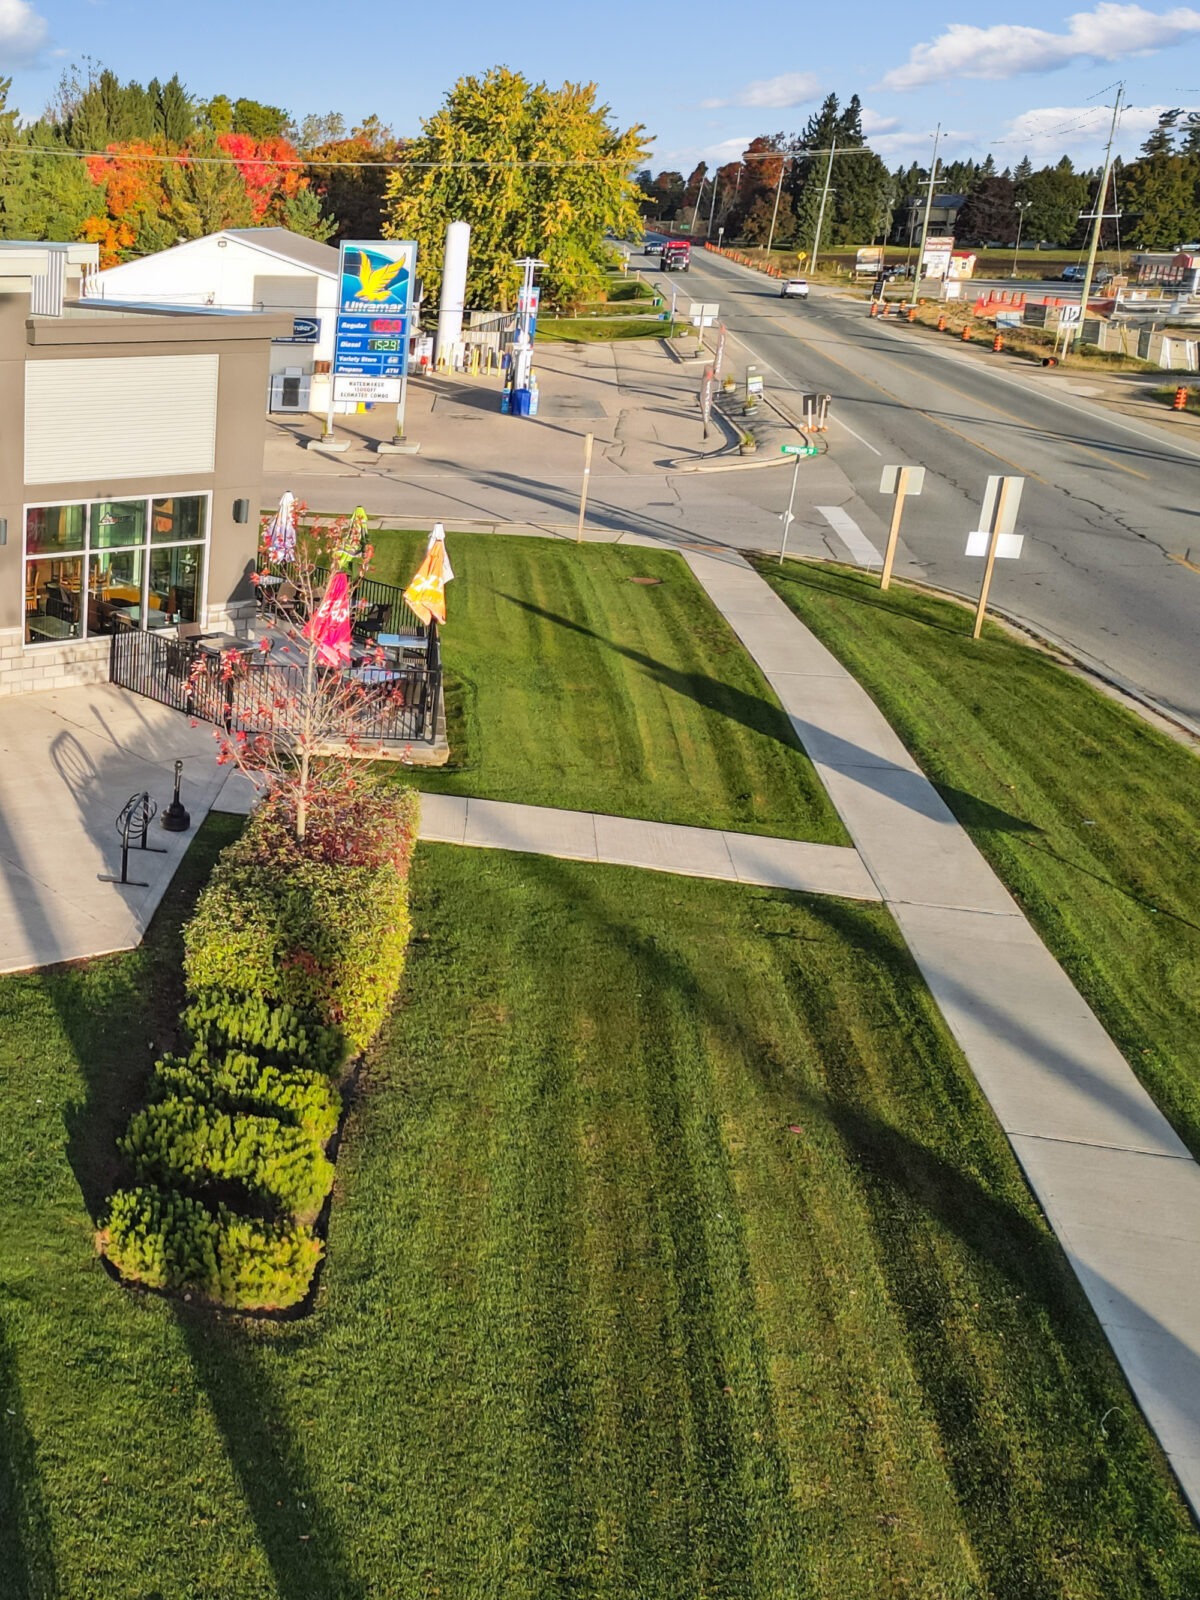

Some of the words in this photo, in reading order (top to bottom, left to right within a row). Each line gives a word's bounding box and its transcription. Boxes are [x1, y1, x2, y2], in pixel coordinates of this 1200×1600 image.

[344, 300, 404, 313] Ultramar
[341, 321, 368, 330] Regular
[340, 340, 362, 348] Diesel
[338, 355, 360, 363] Variety
